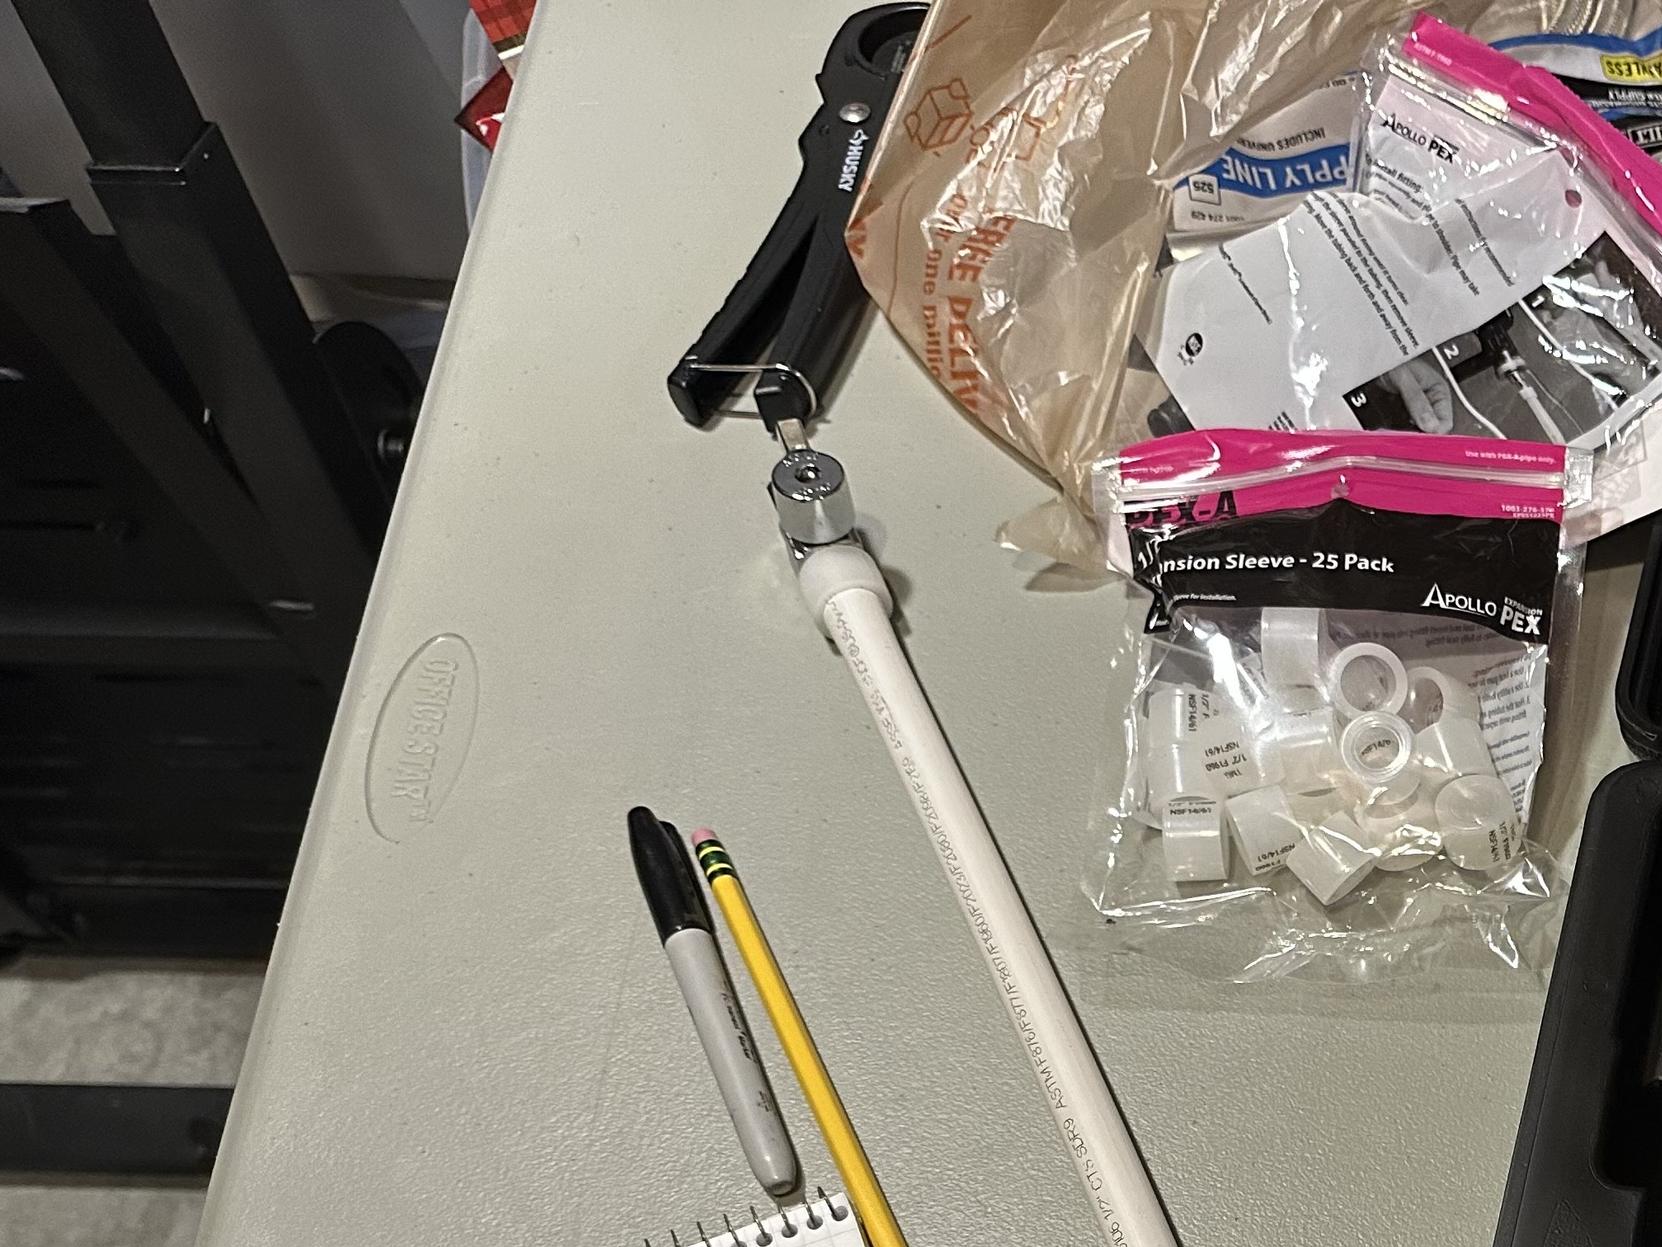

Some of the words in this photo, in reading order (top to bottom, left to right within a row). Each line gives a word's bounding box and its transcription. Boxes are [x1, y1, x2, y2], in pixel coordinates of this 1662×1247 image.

[1277, 127, 1325, 151] INCLUDES
[1428, 139, 1454, 164] PEX
[837, 146, 864, 193] HUSKY
[1222, 155, 1277, 190] LINE
[1192, 181, 1215, 195] 525
[1532, 296, 1545, 308] 1
[1444, 344, 1460, 359] 2
[1351, 392, 1367, 408] 3
[1159, 557, 1220, 573] nsion
[1225, 553, 1295, 570] Sleeve
[1312, 552, 1339, 570] 25
[1344, 553, 1394, 573] Pack
[1421, 582, 1497, 618] APOLLO
[1500, 605, 1541, 635] PEX
[409, 659, 460, 738] OFFICE
[1062, 1117, 1090, 1158] SDR9
